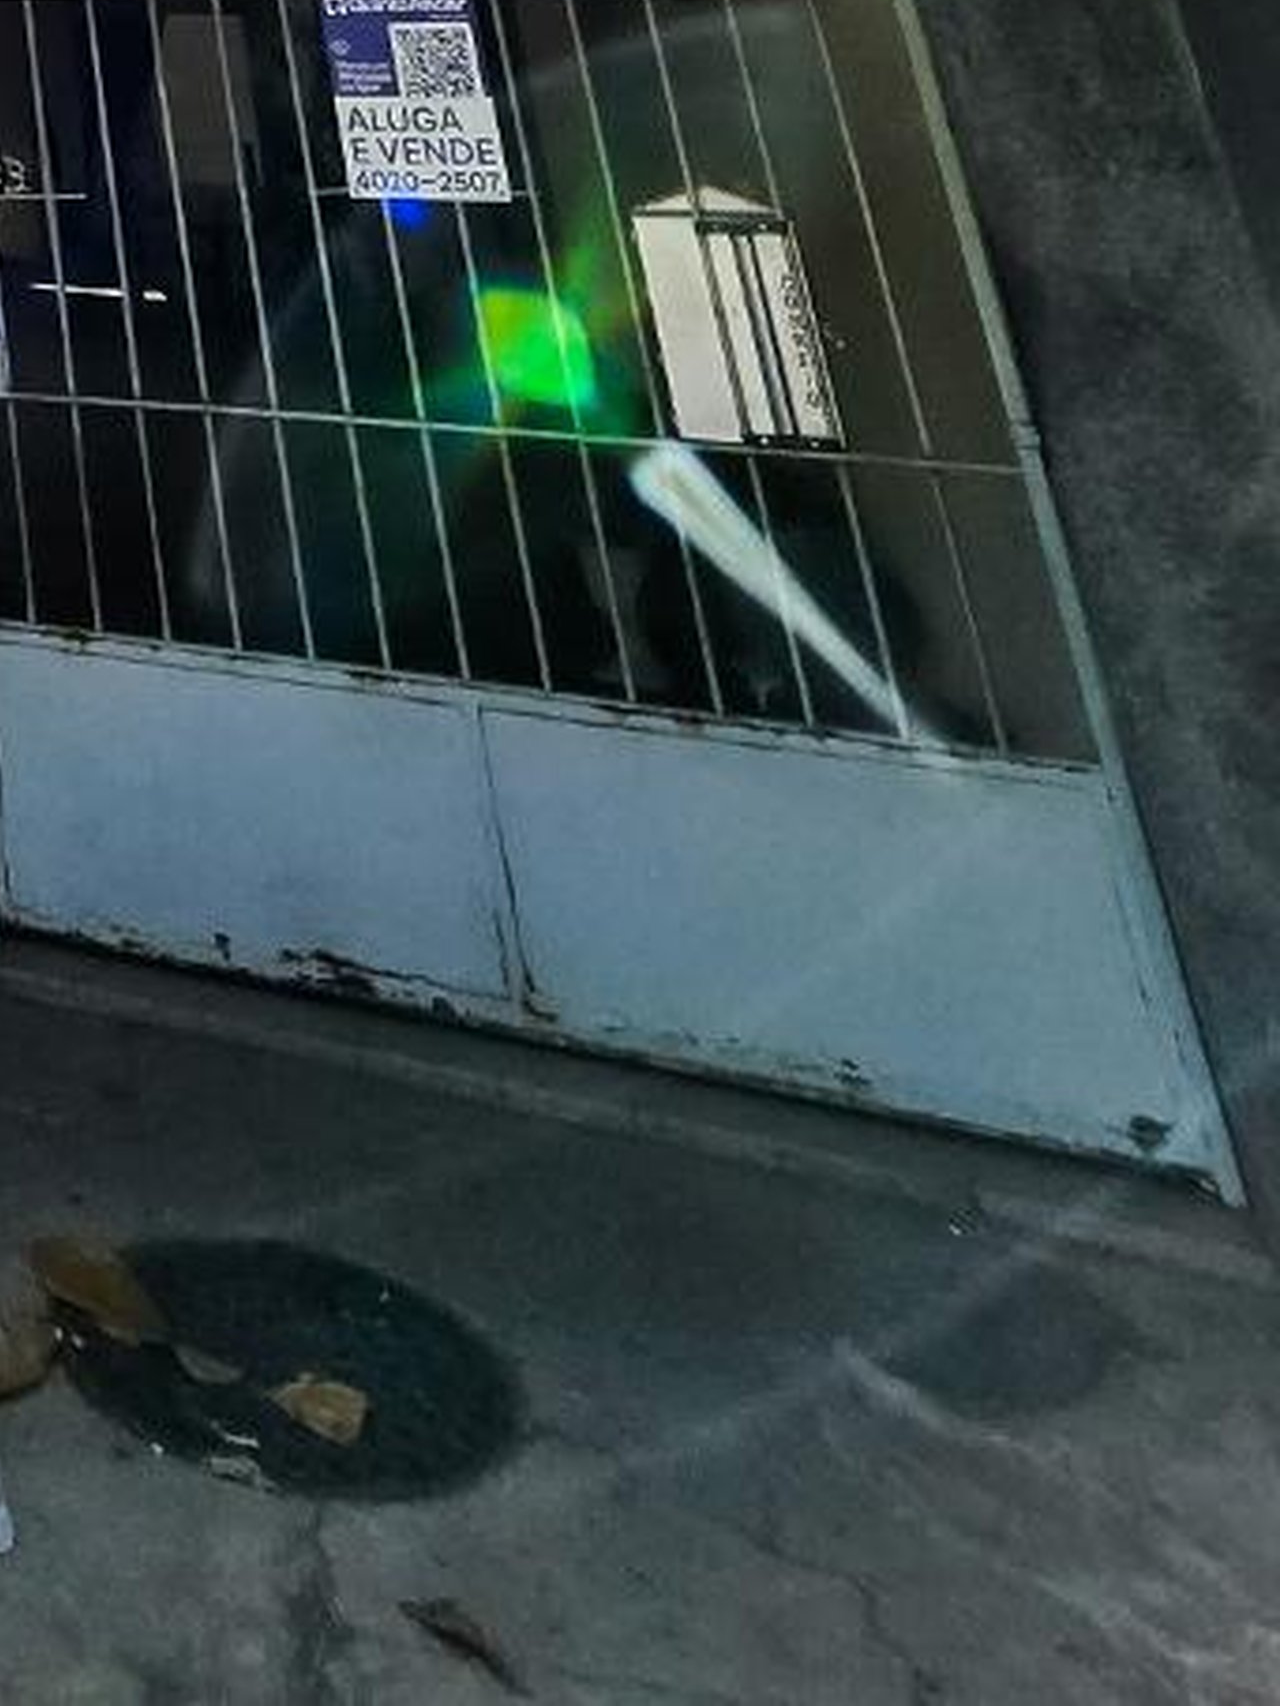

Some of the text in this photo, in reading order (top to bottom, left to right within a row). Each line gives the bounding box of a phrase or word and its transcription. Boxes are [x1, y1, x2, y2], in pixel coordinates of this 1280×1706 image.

[347, 106, 464, 133] ALUGA
[351, 138, 499, 166] E VENDE
